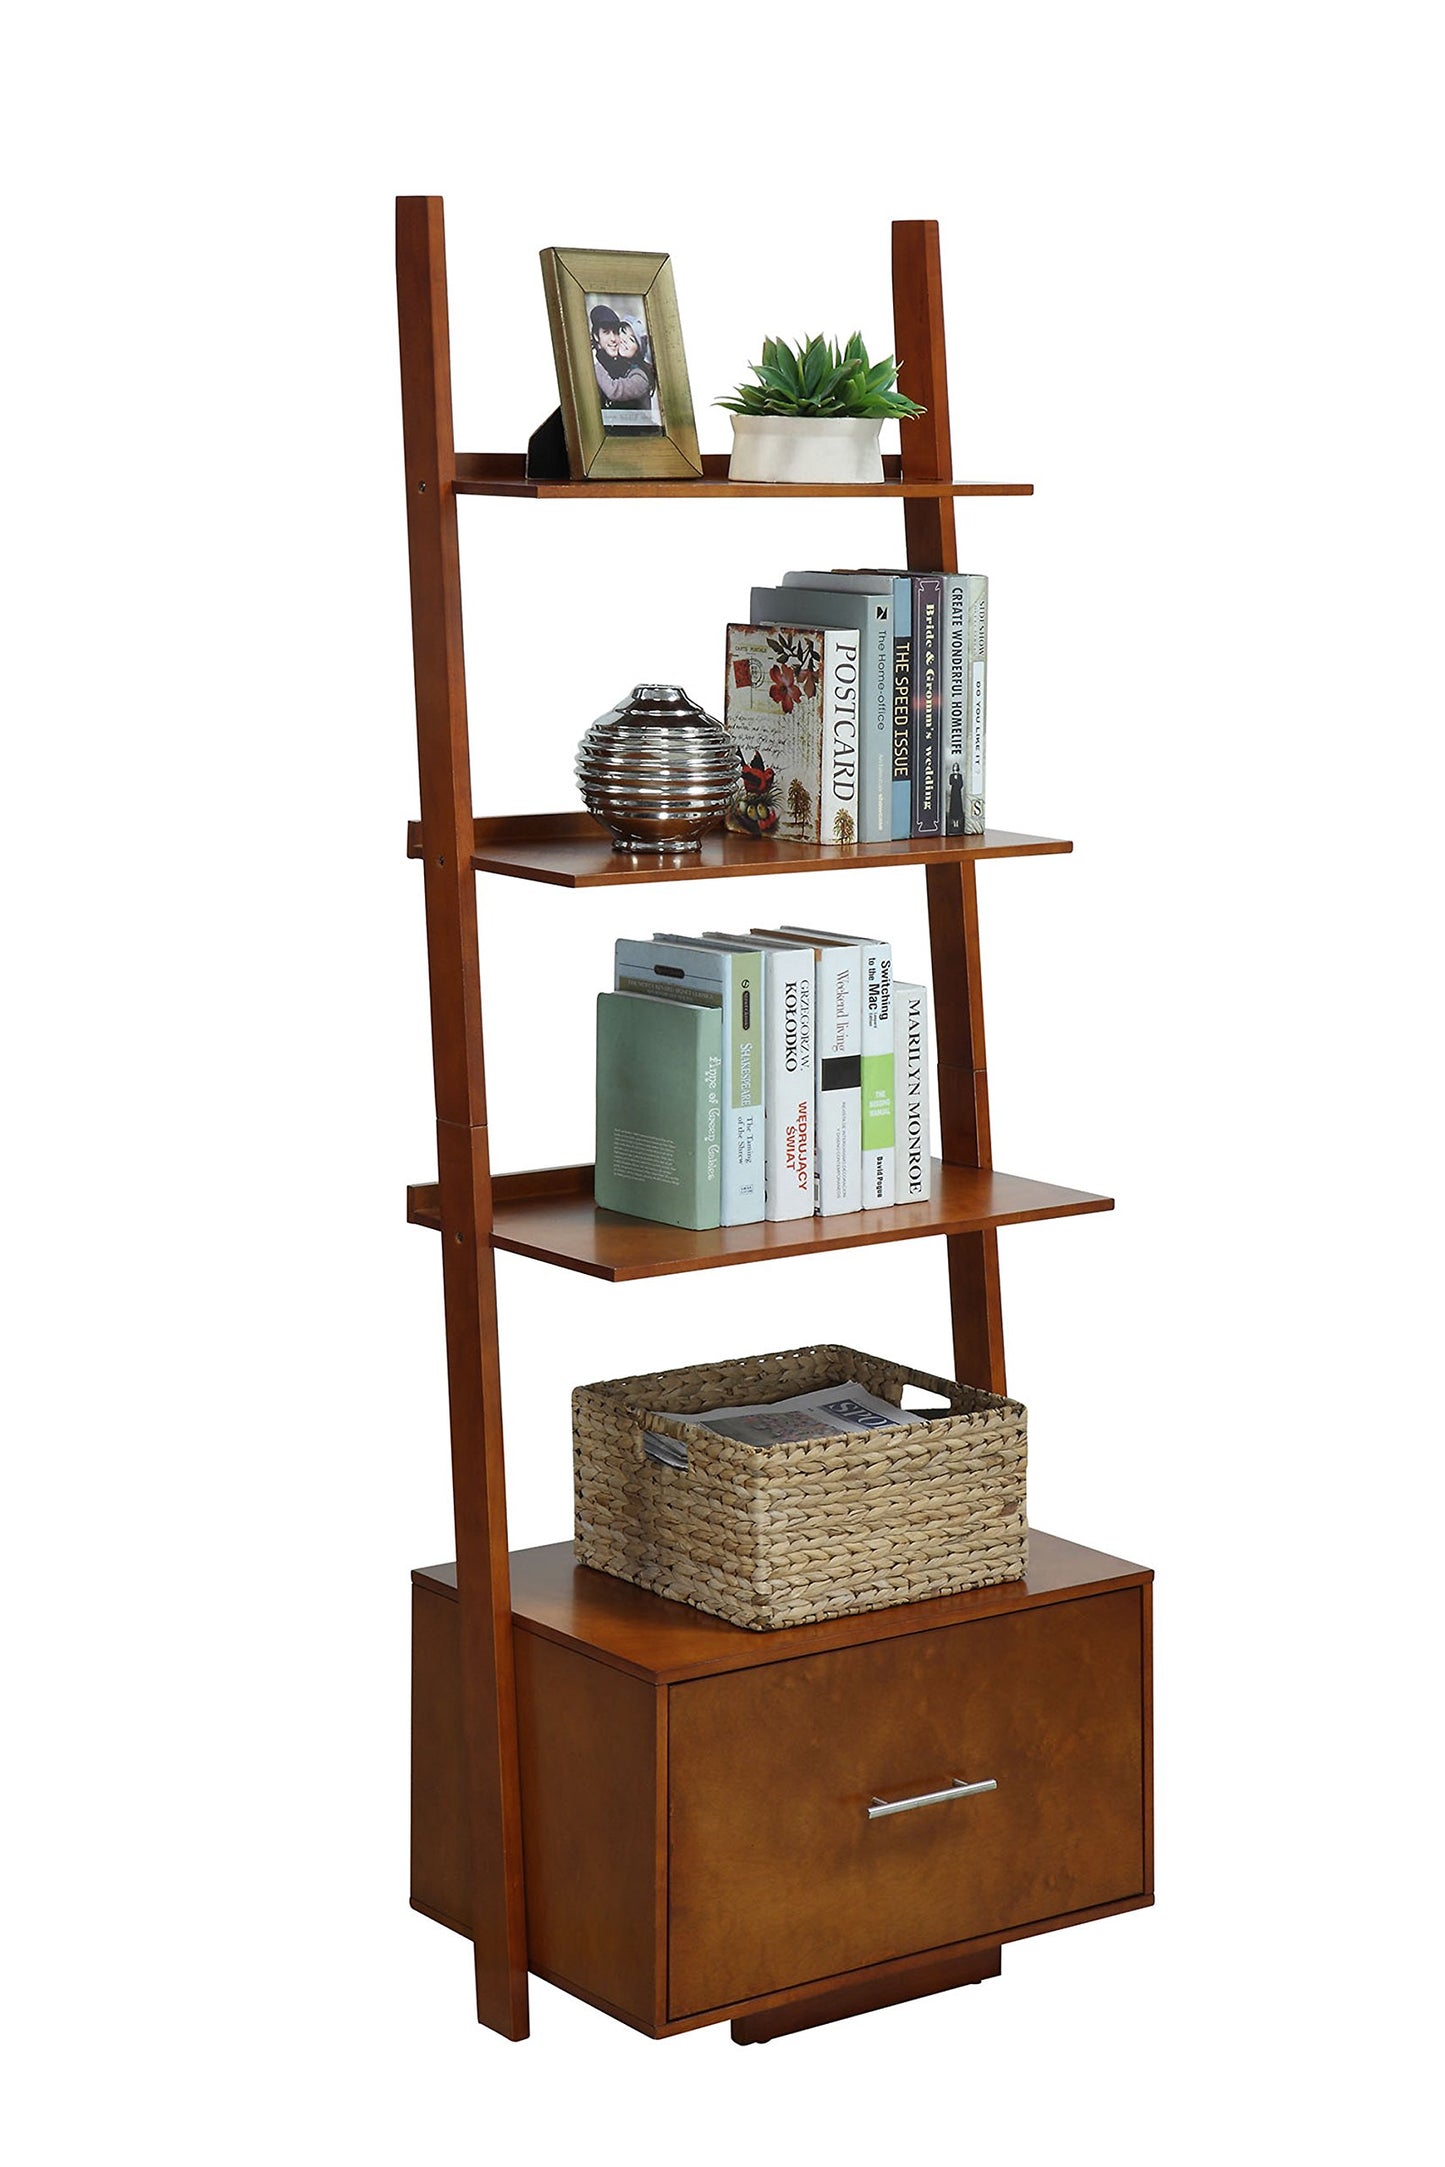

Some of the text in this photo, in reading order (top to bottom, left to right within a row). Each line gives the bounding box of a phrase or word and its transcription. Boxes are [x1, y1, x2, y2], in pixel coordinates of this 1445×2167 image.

[877, 631, 886, 731] The Home-office
[923, 604, 935, 810] Bride & Gromm's wedding
[951, 587, 963, 755] CREATE WONDERFUL HOMELIFE
[975, 681, 981, 697] DO
[832, 642, 856, 802] POSTCARD
[894, 642, 910, 777] THE SPEED ISSUE
[975, 755, 980, 765] IT
[799, 979, 810, 1055] GRZEGORZ
[831, 969, 850, 1052] Weekend living
[868, 957, 880, 1011] to the Mac
[879, 960, 891, 1020] Switching
[785, 982, 798, 1072] KOŁODKO
[708, 1092, 718, 1104] of
[738, 1116, 745, 1126] of
[908, 999, 922, 1195] MARILYN MONROE
[745, 1135, 753, 1164] Taming
[786, 1126, 797, 1170] ŚWIAT
[796, 1101, 808, 1191] WĘDRUJĄCY
[875, 1176, 883, 1199] Pogue
